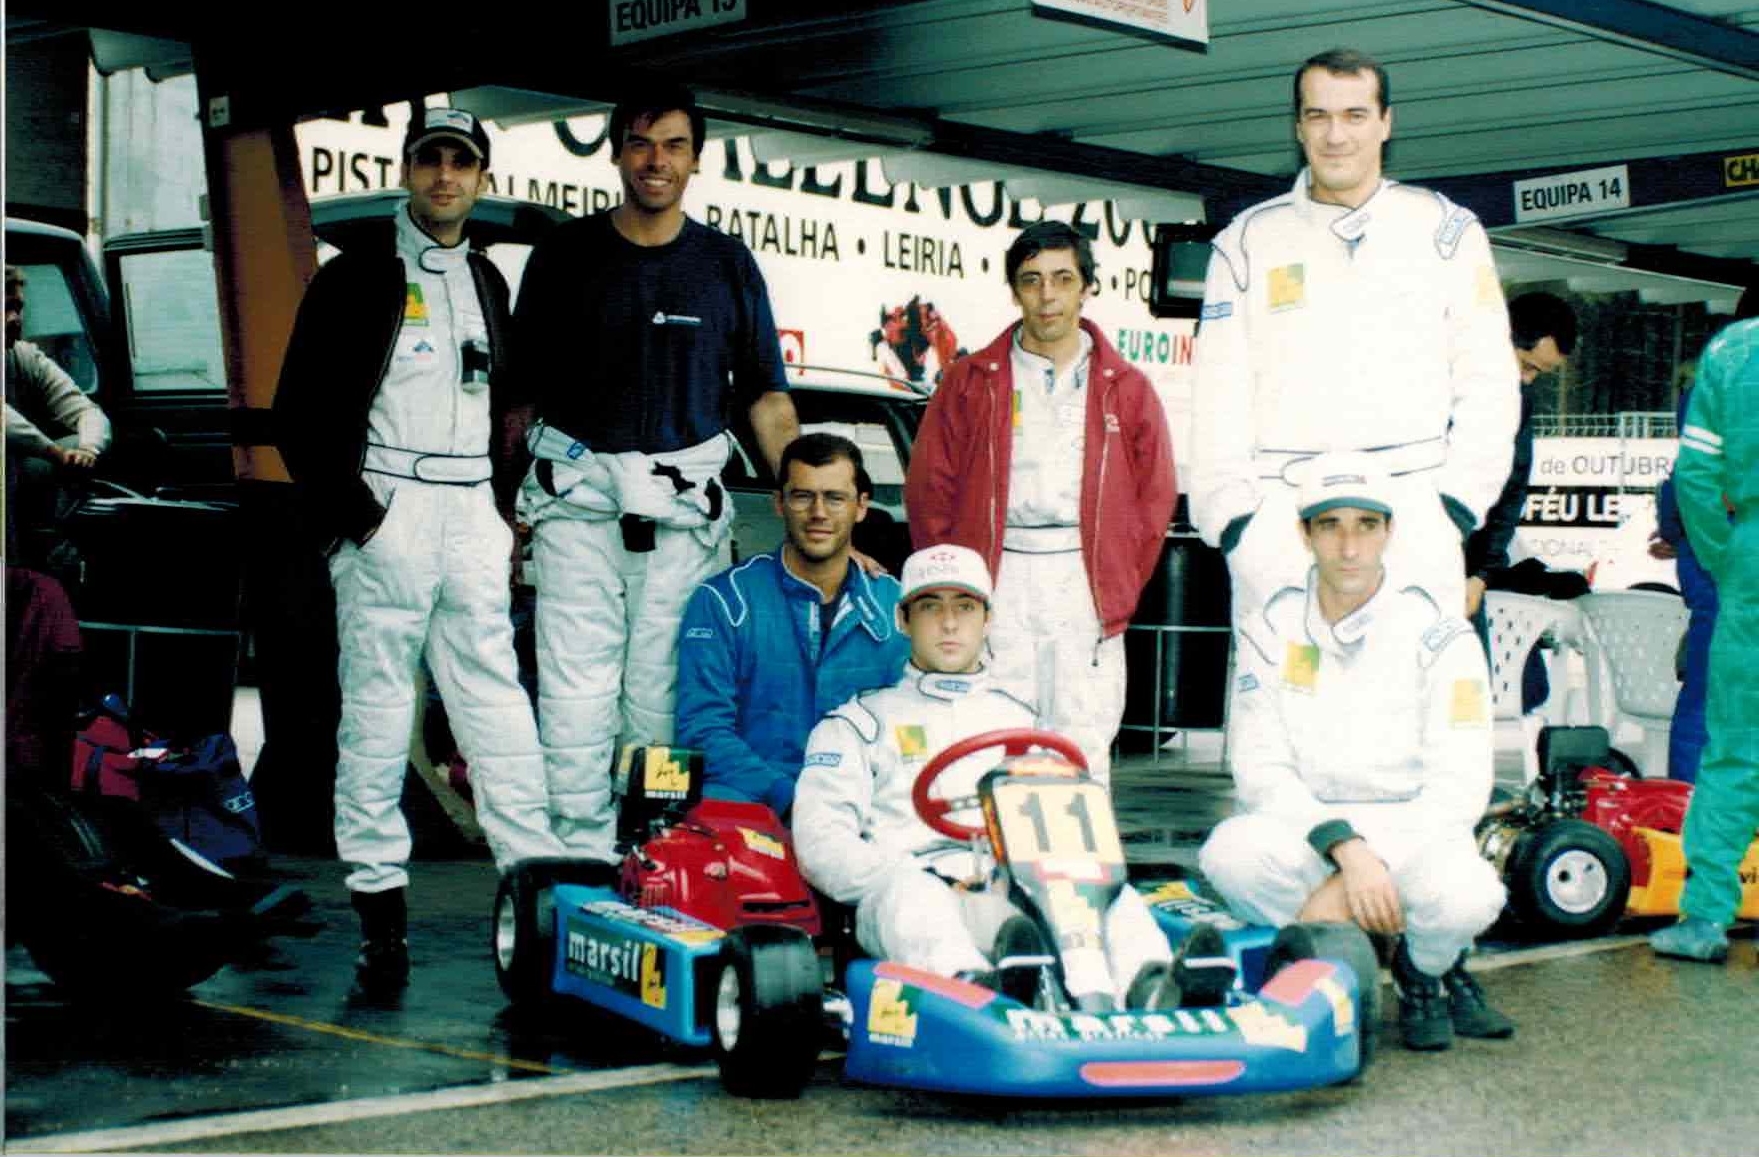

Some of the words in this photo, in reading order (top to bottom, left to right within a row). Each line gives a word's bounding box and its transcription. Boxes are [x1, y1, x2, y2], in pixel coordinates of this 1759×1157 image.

[312, 147, 394, 192] PIST
[884, 231, 964, 279] LEIRIA
[1521, 184, 1591, 211] EQUIPA
[1599, 177, 1622, 200] 14
[1540, 458, 1566, 475] de
[1572, 455, 1670, 476] OUTUBR
[1525, 485, 1580, 522] FÉU
[1019, 792, 1096, 852] 11
[568, 930, 641, 982] marsil
